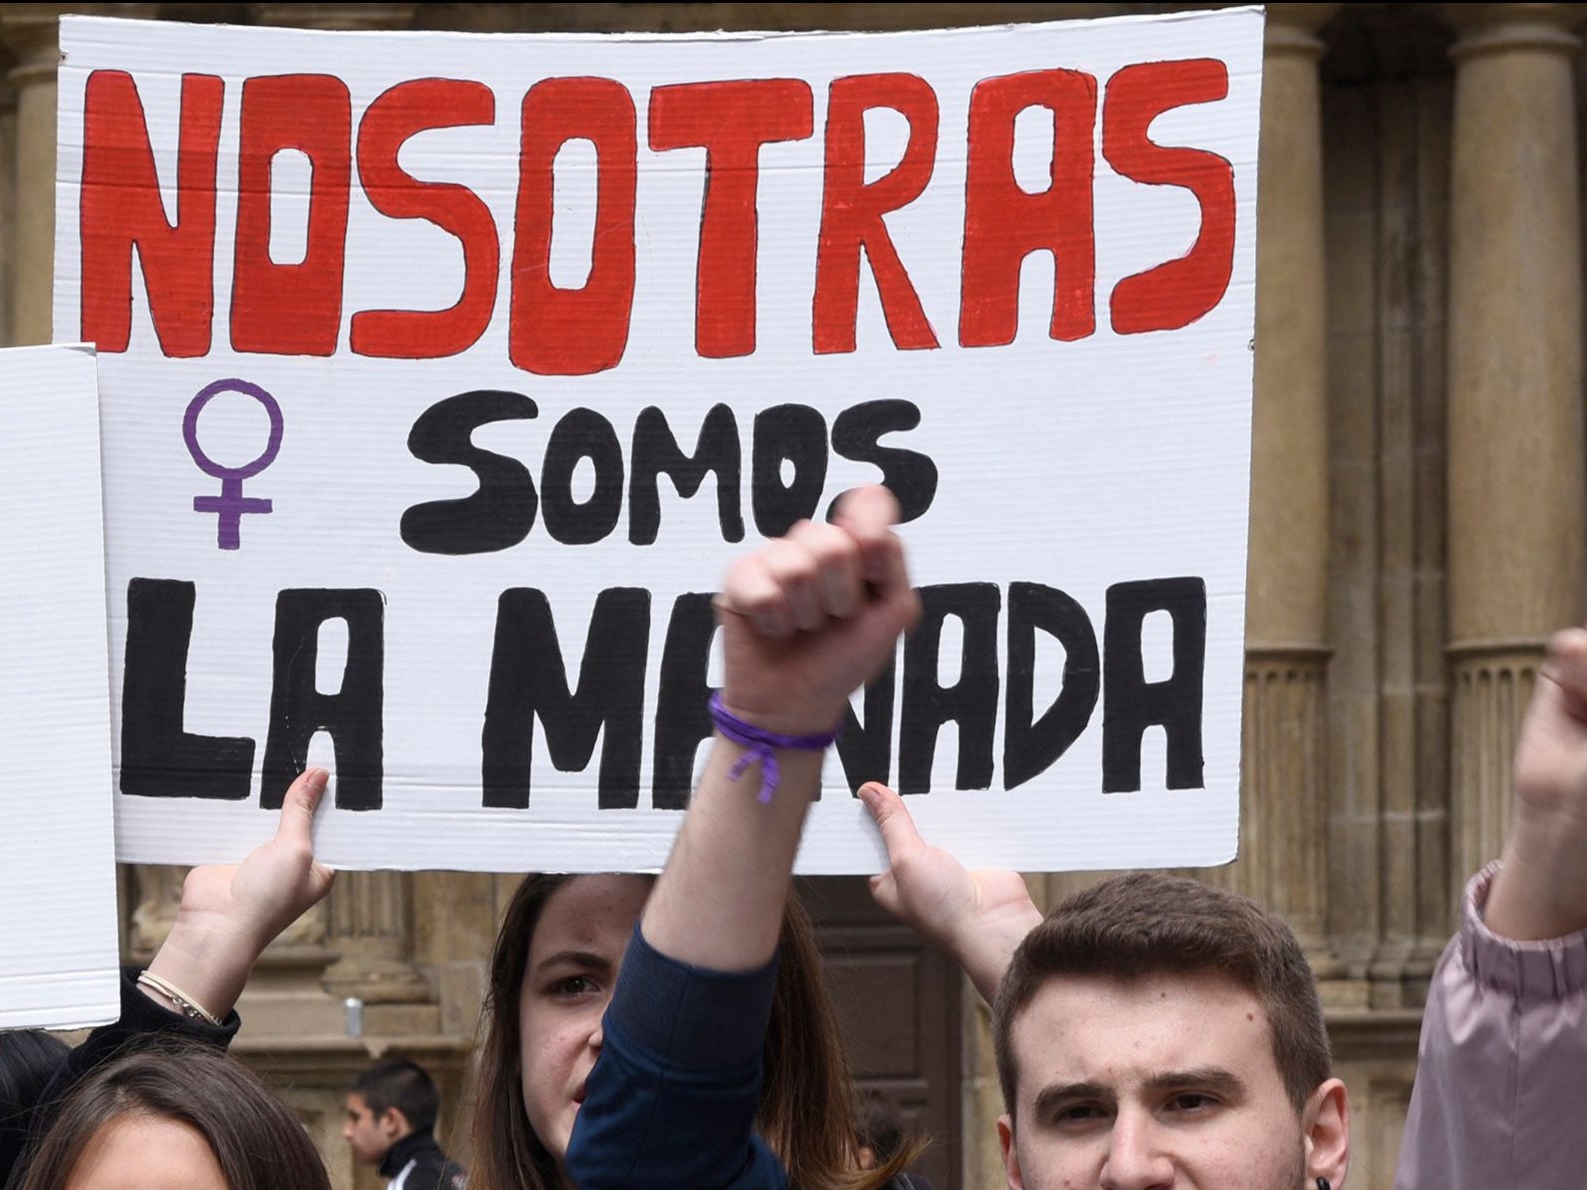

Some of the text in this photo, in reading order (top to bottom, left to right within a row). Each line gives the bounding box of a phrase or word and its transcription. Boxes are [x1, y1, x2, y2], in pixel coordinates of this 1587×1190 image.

[80, 57, 1237, 376] NOSOTRAS
[400, 389, 939, 556] SOMOS
[120, 576, 385, 810] LA
